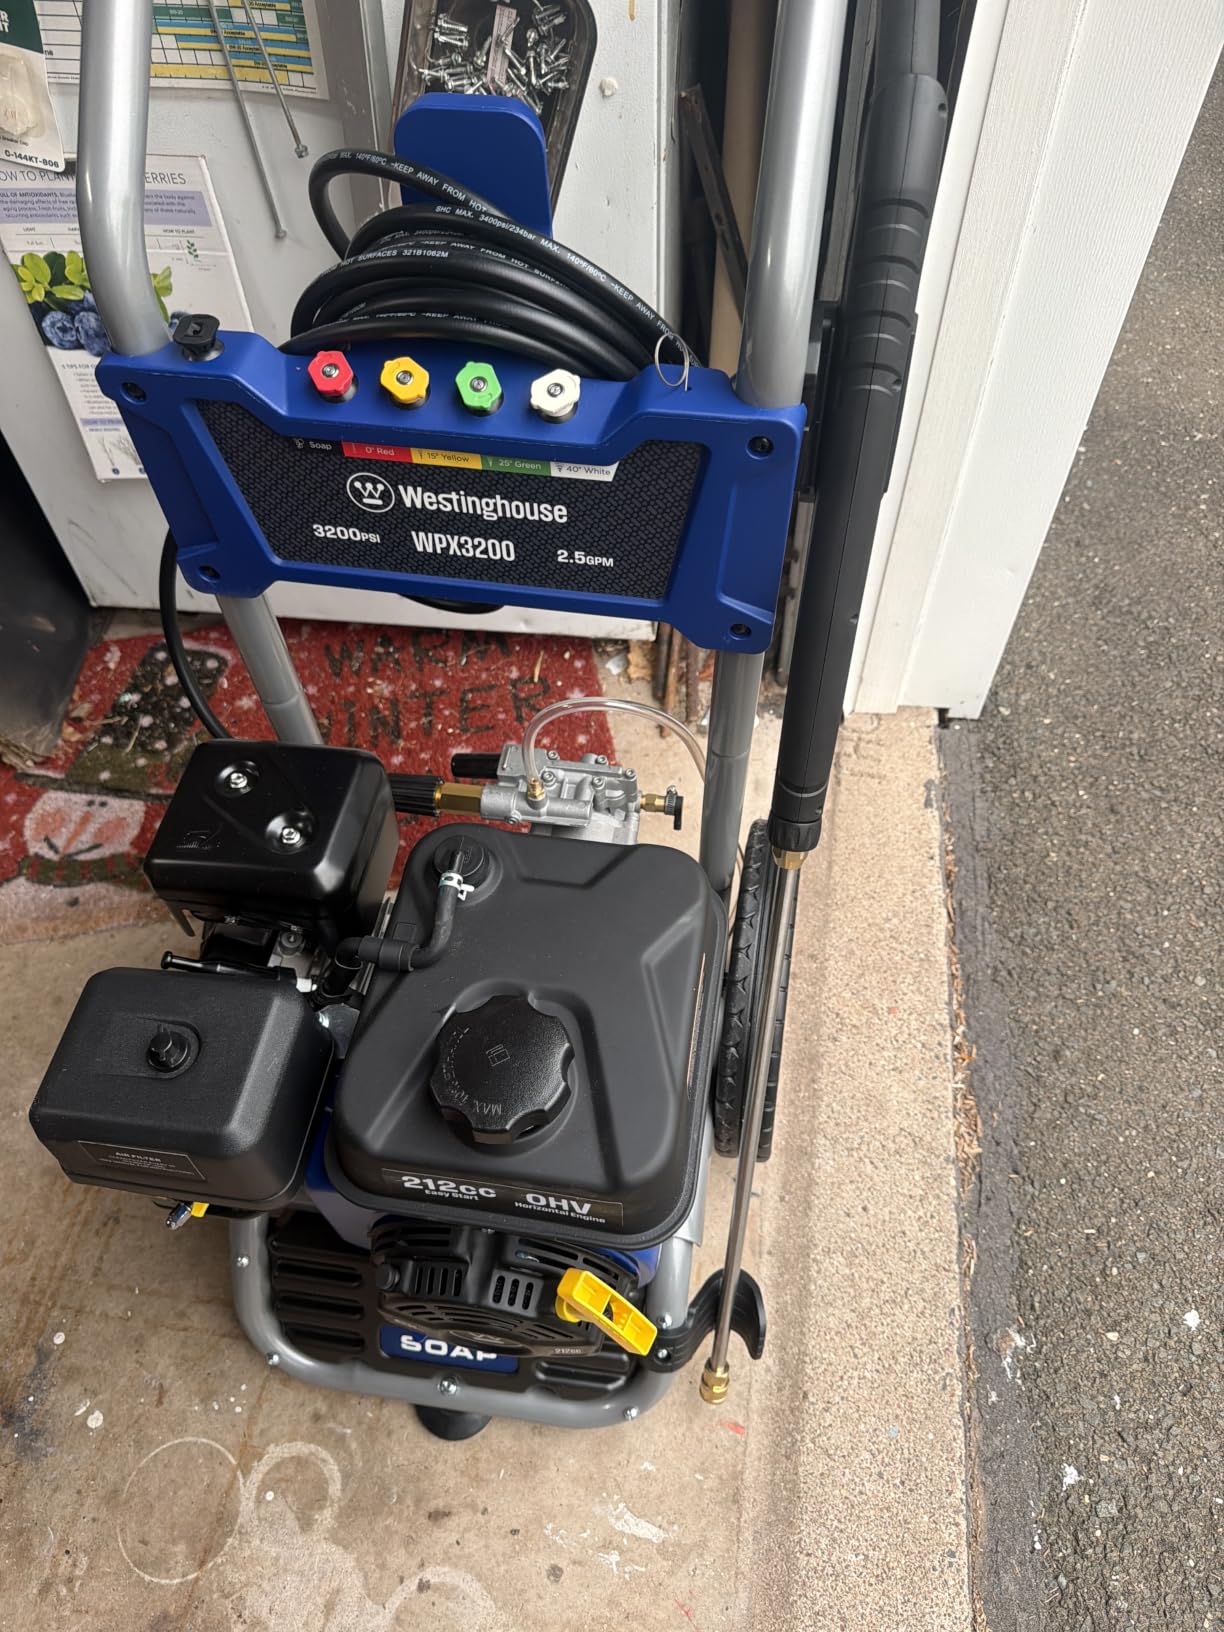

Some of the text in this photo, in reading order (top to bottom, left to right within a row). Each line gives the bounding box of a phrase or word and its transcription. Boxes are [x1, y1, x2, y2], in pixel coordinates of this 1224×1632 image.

[20, 171, 37, 182] TO
[416, 170, 440, 186] AWAY
[442, 183, 467, 202] FROM
[358, 249, 398, 262] SURFACES
[455, 207, 475, 219] MAX.
[479, 213, 537, 241] 3400psi/234bar
[540, 238, 561, 255] MAX.
[635, 302, 656, 321] AWAY
[480, 247, 507, 260] FROM
[511, 257, 531, 269] HOT
[309, 441, 332, 451] Soap
[376, 446, 395, 456] Red
[441, 453, 470, 463] Yellow
[514, 460, 542, 470] Green
[584, 465, 611, 477] White
[398, 484, 568, 524] Westinghouse
[312, 523, 615, 568] 3200PSI WPX3200 2.5GPM
[401, 1175, 497, 1199] 212cc
[425, 1189, 479, 1201] Easy Start
[514, 1201, 606, 1224] Horizontal Engine
[525, 1193, 592, 1215] OHV
